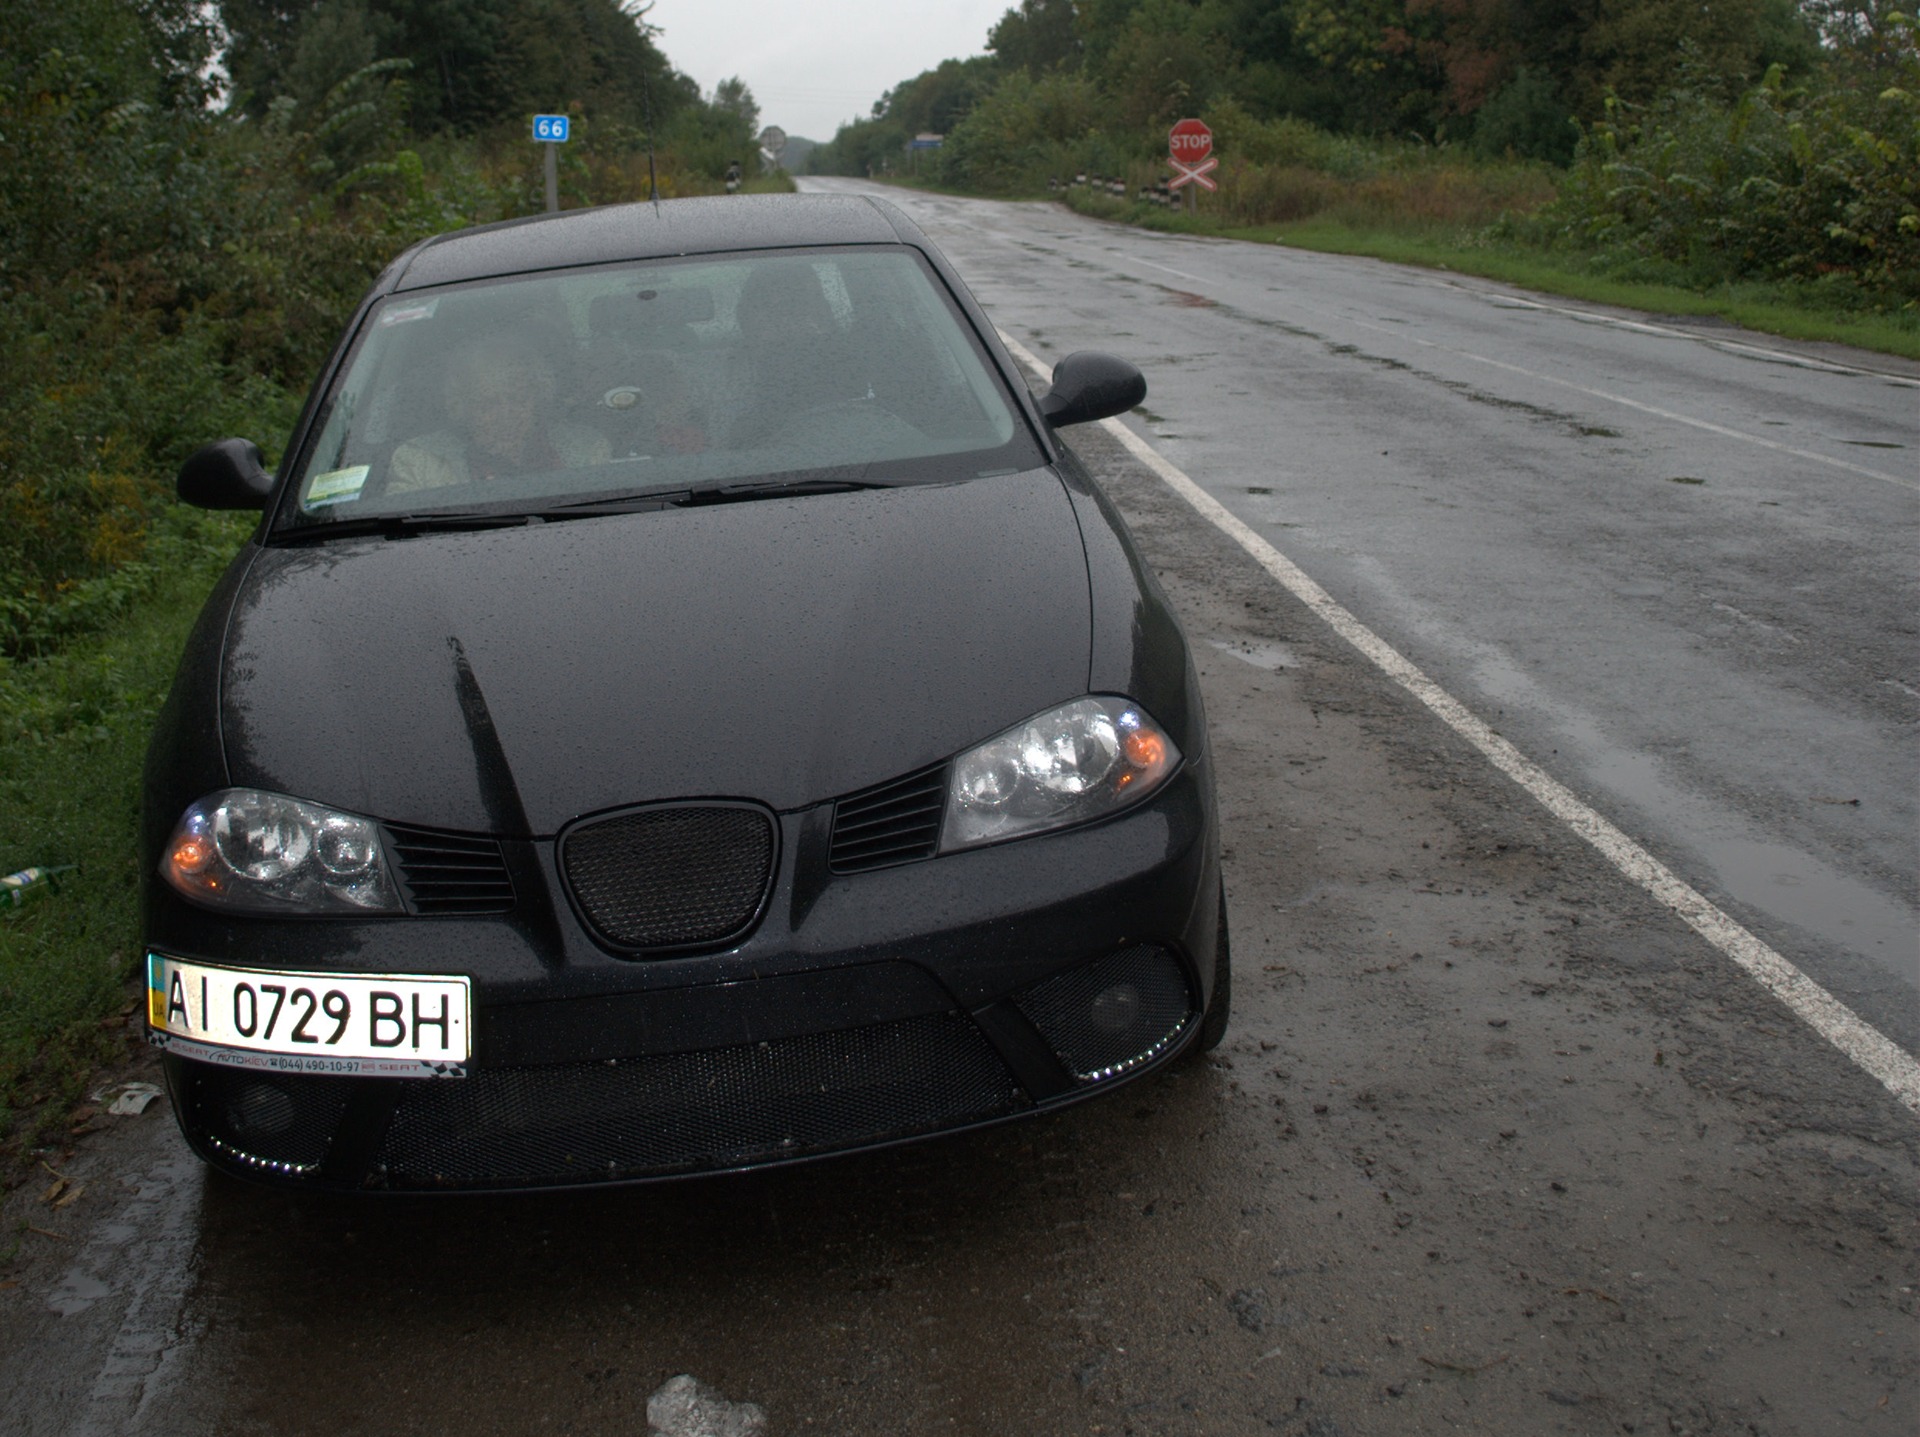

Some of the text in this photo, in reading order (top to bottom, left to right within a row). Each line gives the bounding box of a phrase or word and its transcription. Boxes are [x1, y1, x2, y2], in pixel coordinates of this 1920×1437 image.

[538, 119, 563, 137] 66
[1171, 134, 1210, 149] STOP
[167, 969, 449, 1050] AI 0729 BH
[279, 1056, 303, 1071] (044)
[305, 1060, 360, 1072] 490-10-97
[378, 1063, 420, 1071] SEAT
